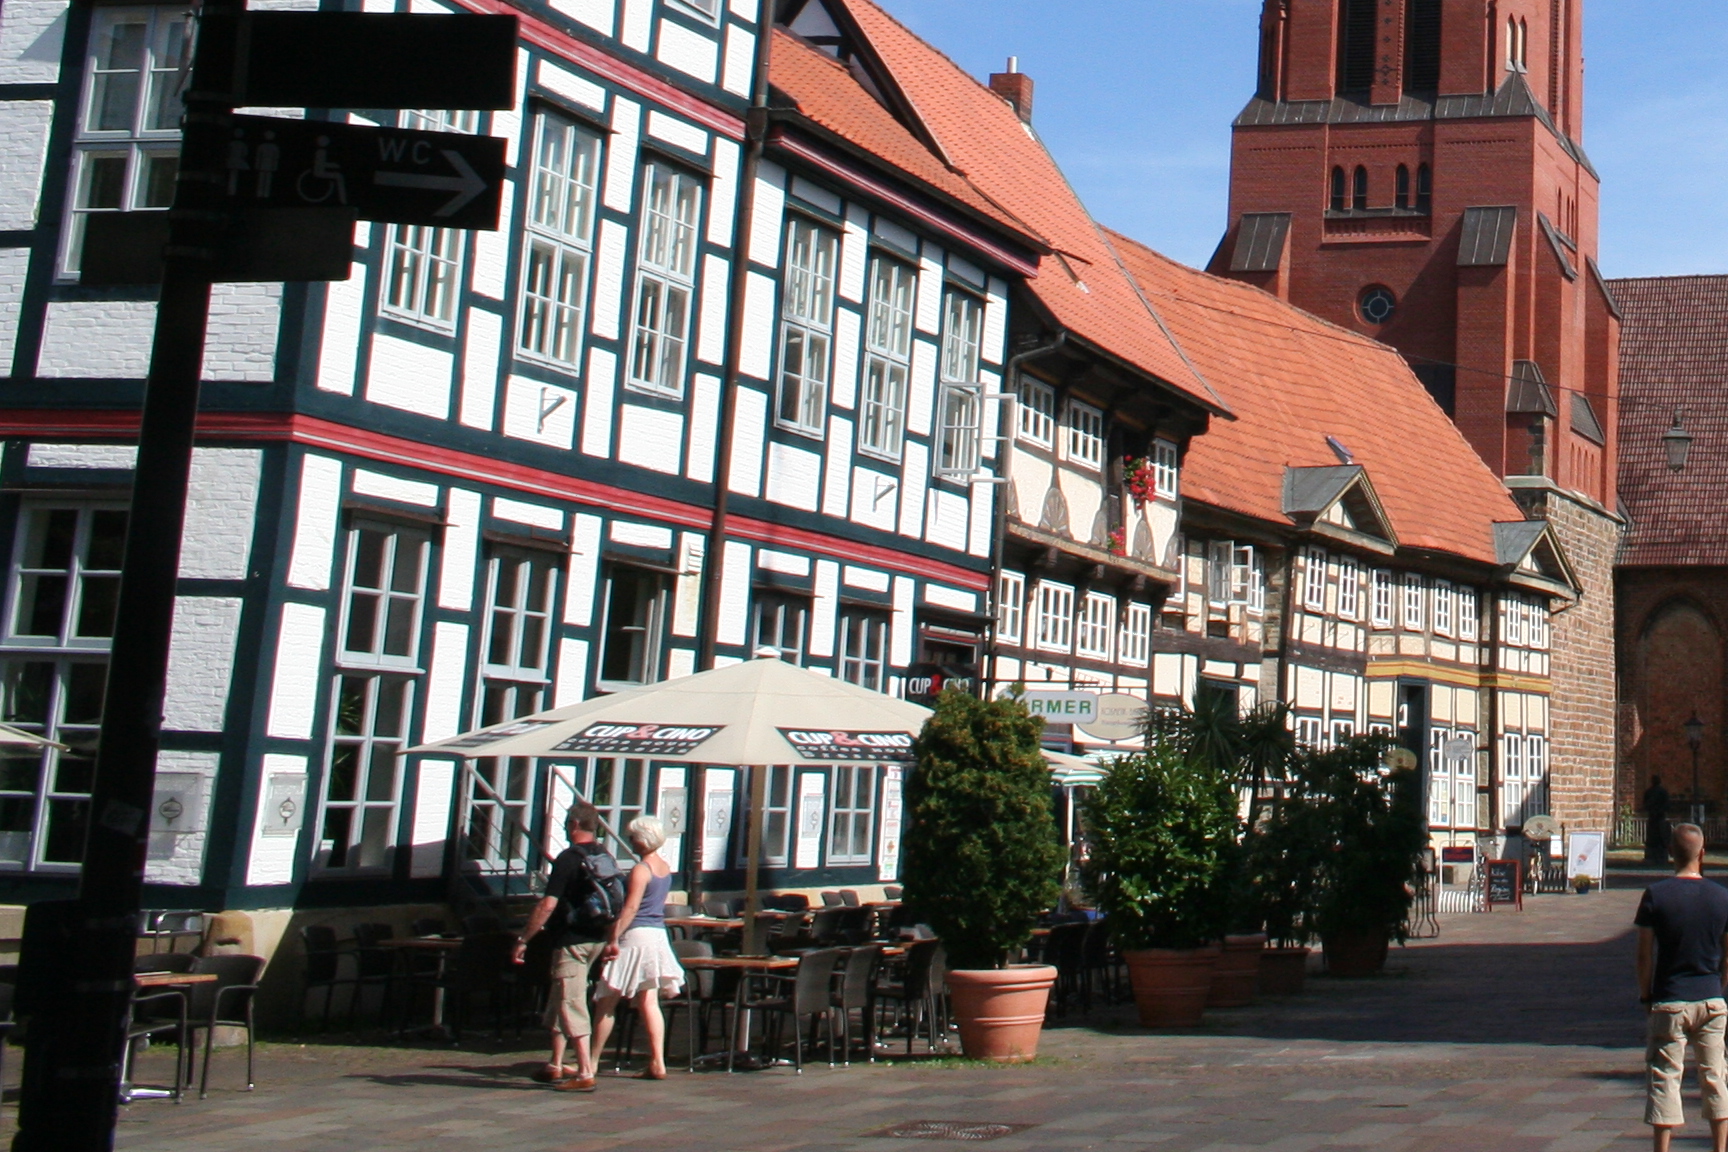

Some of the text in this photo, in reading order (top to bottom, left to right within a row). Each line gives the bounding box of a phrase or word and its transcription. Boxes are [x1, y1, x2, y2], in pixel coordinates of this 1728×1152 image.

[377, 136, 433, 166] WC
[908, 674, 970, 695] CUP&CNO
[1031, 699, 1092, 715] RMER
[583, 724, 711, 740] CUP&CINO
[787, 730, 911, 747] CUP&CINO
